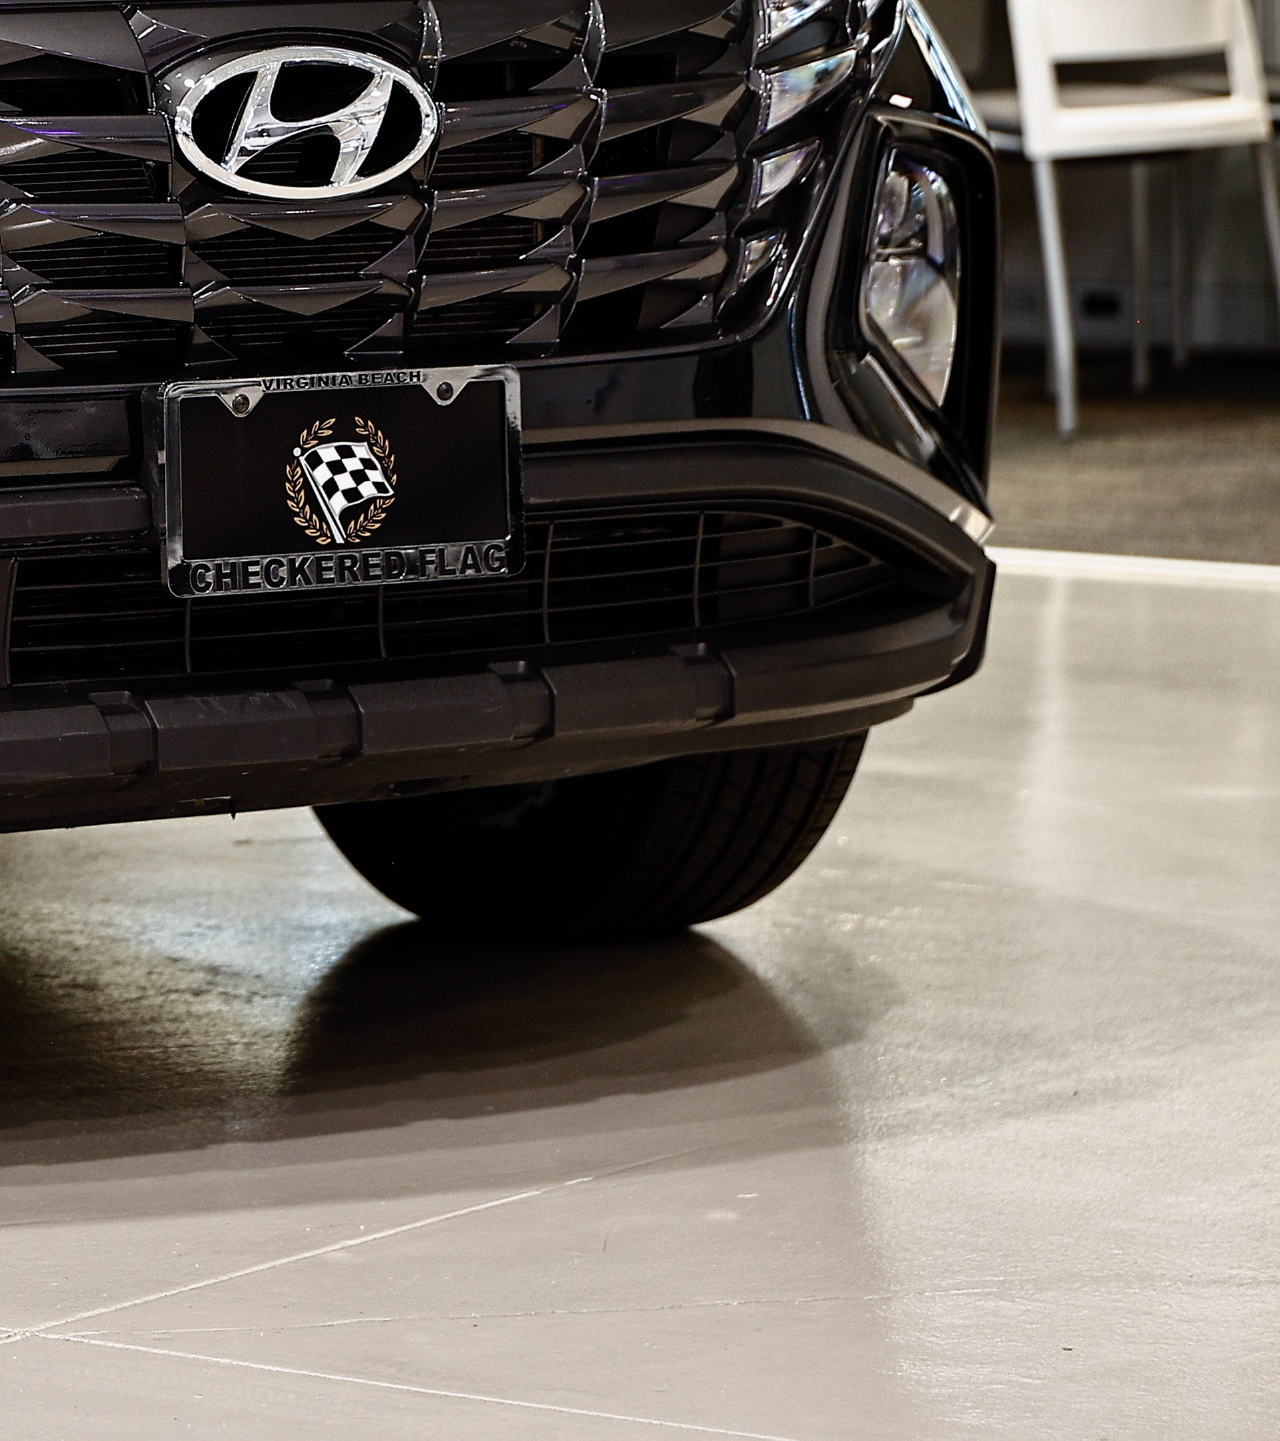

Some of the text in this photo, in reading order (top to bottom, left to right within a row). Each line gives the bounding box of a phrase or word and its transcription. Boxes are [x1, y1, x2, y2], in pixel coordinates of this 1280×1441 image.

[261, 370, 421, 391] VIRGINIA BEACH
[190, 542, 507, 595] CHECKERED FLAG
